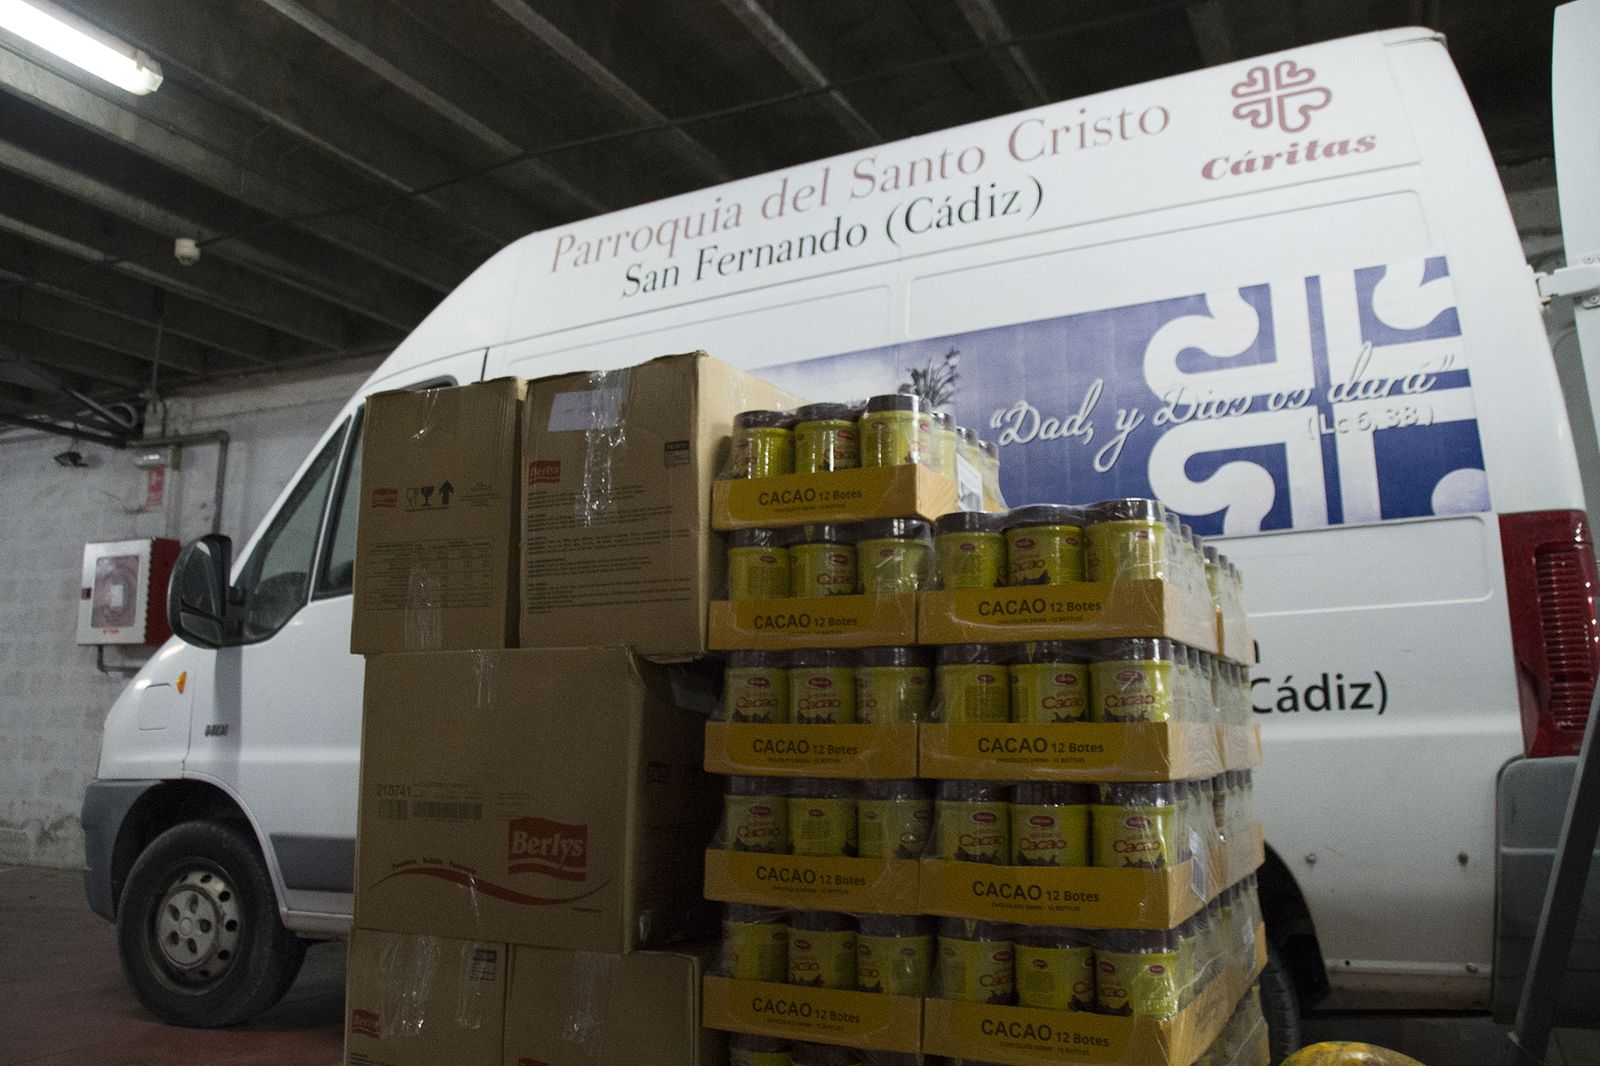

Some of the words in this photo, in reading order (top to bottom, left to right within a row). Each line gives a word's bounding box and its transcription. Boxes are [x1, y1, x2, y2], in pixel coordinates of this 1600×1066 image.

[1201, 134, 1377, 181] Cáritas
[550, 195, 744, 273] Parroquia
[762, 168, 830, 220] del
[849, 145, 986, 201] Santo
[1008, 104, 1170, 163] Cristo
[622, 263, 681, 298] San
[695, 216, 868, 281] Fernando
[886, 175, 1045, 248] (Cádiz)
[1094, 407, 1146, 473] y
[1152, 383, 1253, 426] Dios
[759, 488, 816, 506] CACAO
[818, 491, 830, 500] 12
[833, 490, 862, 500] Botes
[978, 597, 1045, 616] CACAO
[1050, 603, 1063, 612] 12
[1067, 601, 1102, 611] Botes
[754, 613, 811, 629] CACAO
[815, 618, 826, 627] 12
[828, 617, 858, 626] Botes
[1104, 694, 1155, 709] Cacao
[1250, 670, 1389, 715] Cádiz)
[753, 739, 809, 754] CACAO
[813, 744, 824, 754] 12
[827, 744, 858, 754] Botes
[978, 737, 1048, 753] CACAO
[1052, 743, 1065, 753] 12
[1068, 742, 1104, 753] Botes
[510, 829, 584, 866] Berlys
[1019, 837, 1067, 851] Cacao
[756, 866, 816, 884] CACAO
[820, 875, 832, 885] 12
[835, 875, 866, 885] Botes
[972, 880, 1042, 900] CACAO
[1046, 891, 1060, 901] 12
[1064, 890, 1100, 902] Botes
[752, 997, 813, 1018] CACAO
[815, 1009, 827, 1020] 12
[830, 1010, 861, 1024] Botes
[981, 1018, 1052, 1041] CACAO
[1056, 1031, 1069, 1043] 12
[1074, 1032, 1109, 1047] Botes
